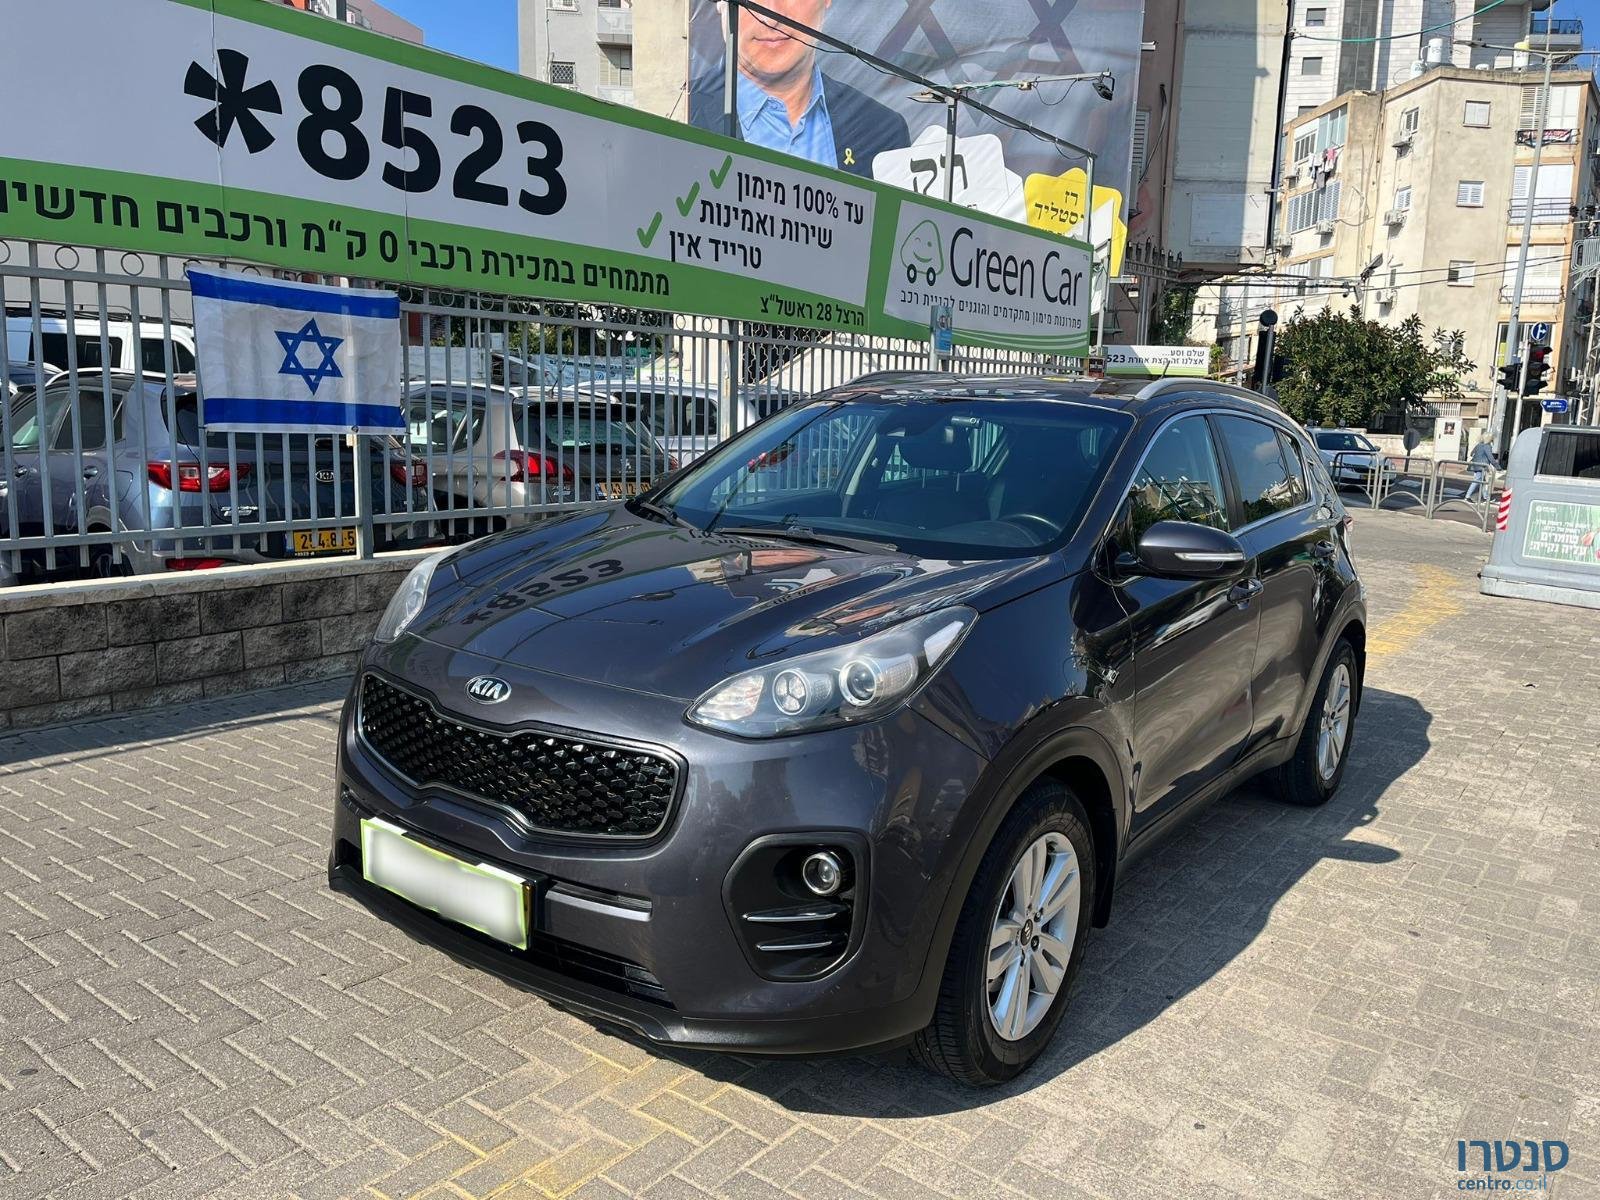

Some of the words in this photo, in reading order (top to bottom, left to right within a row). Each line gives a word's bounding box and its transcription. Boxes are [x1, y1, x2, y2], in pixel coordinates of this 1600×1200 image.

[737, 171, 786, 206] מימון
[793, 183, 839, 219] 100%
[156, 200, 288, 248] ורכבים
[699, 199, 775, 237] ואמינות
[843, 200, 864, 225] עד
[379, 229, 399, 263] 0
[669, 230, 702, 263] אין
[780, 218, 833, 249] שירות
[407, 239, 472, 272] רכבי
[480, 249, 576, 285] במכירת
[708, 238, 762, 269] טרייד
[950, 227, 1035, 299] Green
[1042, 250, 1083, 307] Car
[583, 262, 670, 297] מתמחים
[816, 301, 833, 322] 28
[900, 289, 919, 305] רכב
[959, 300, 990, 316] והוגנים
[835, 303, 865, 327] הרצל
[993, 305, 1030, 323] מתקדמים
[1032, 312, 1052, 326] מימון
[1054, 315, 1082, 329] פתרונות
[470, 677, 503, 700] KIA
